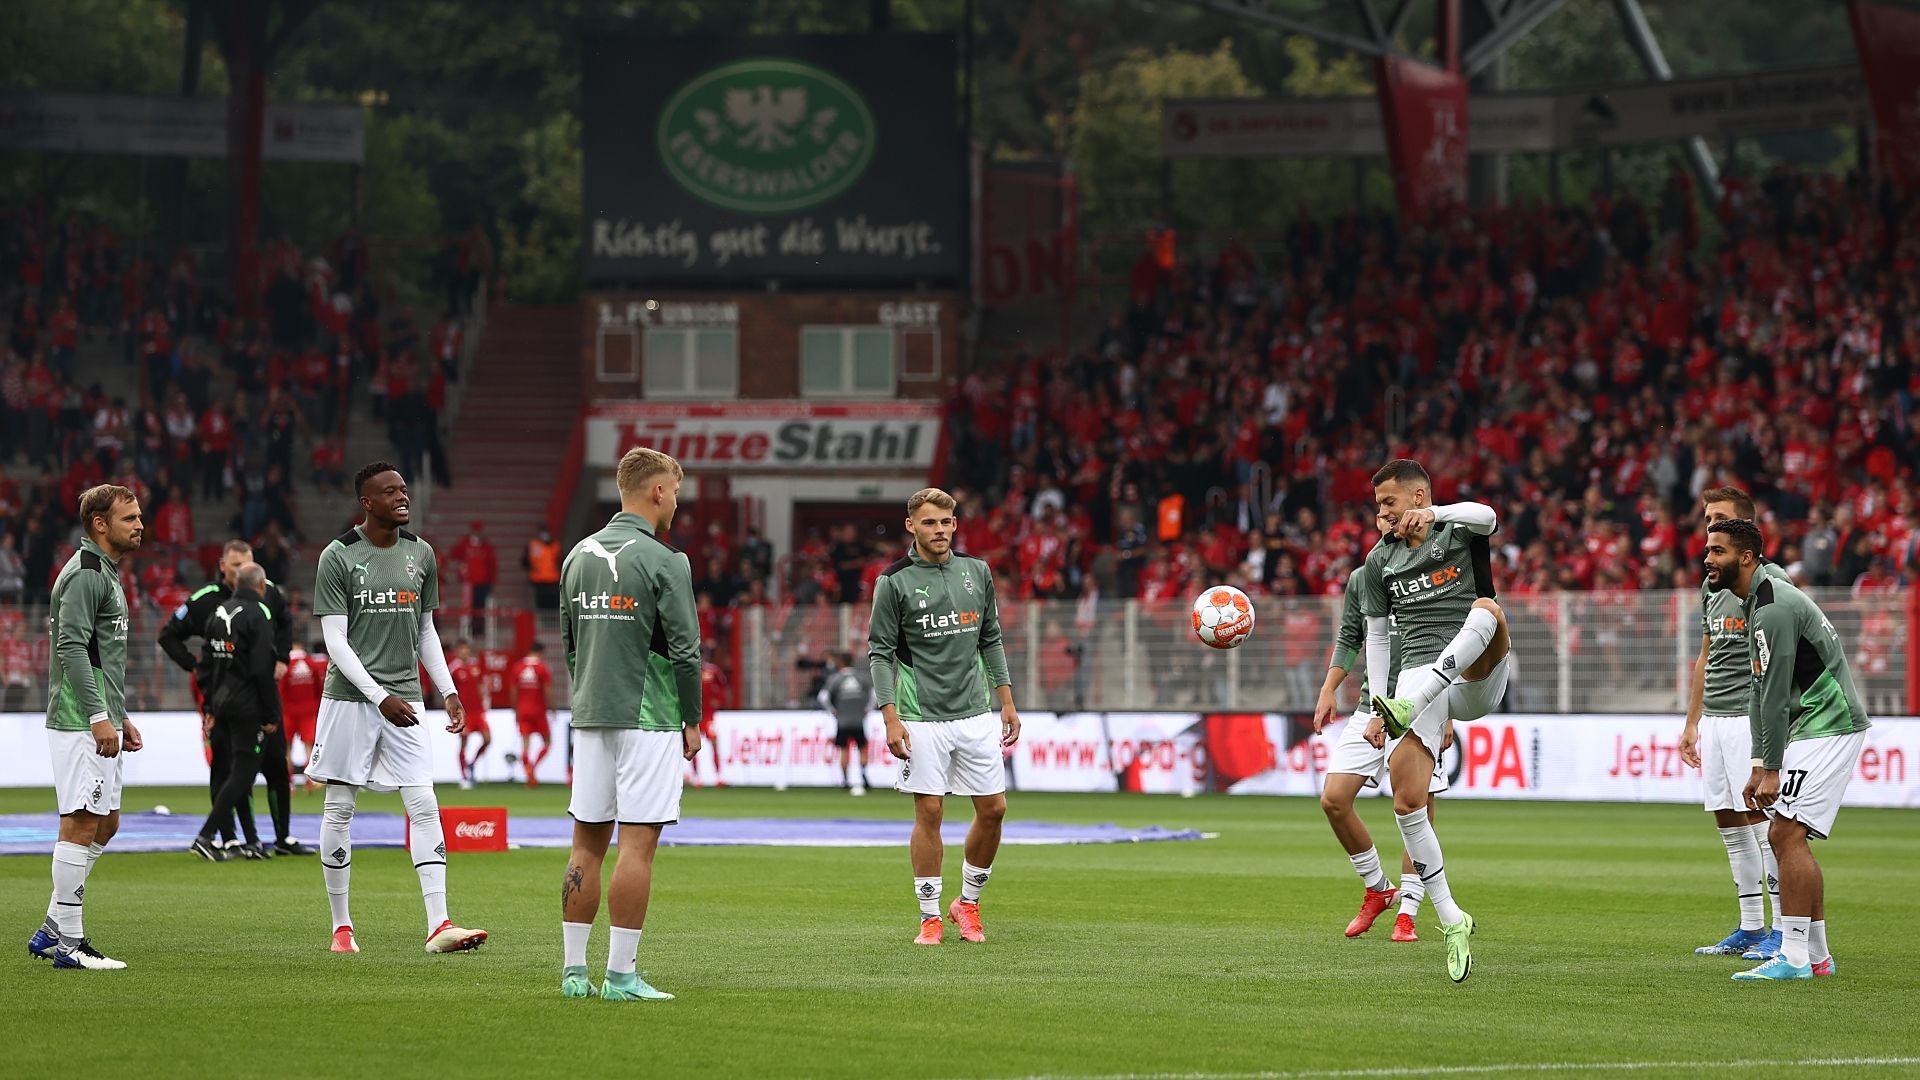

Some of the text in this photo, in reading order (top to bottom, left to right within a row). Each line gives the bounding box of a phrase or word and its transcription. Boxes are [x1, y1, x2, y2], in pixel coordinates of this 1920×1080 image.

[669, 129, 862, 195] EBERSWALDER
[593, 213, 942, 268] Richtig gut die Wurst.
[662, 304, 739, 323] UNION
[877, 304, 942, 323] GAST
[727, 728, 783, 766] Jetzt
[1781, 769, 1809, 798] 37
